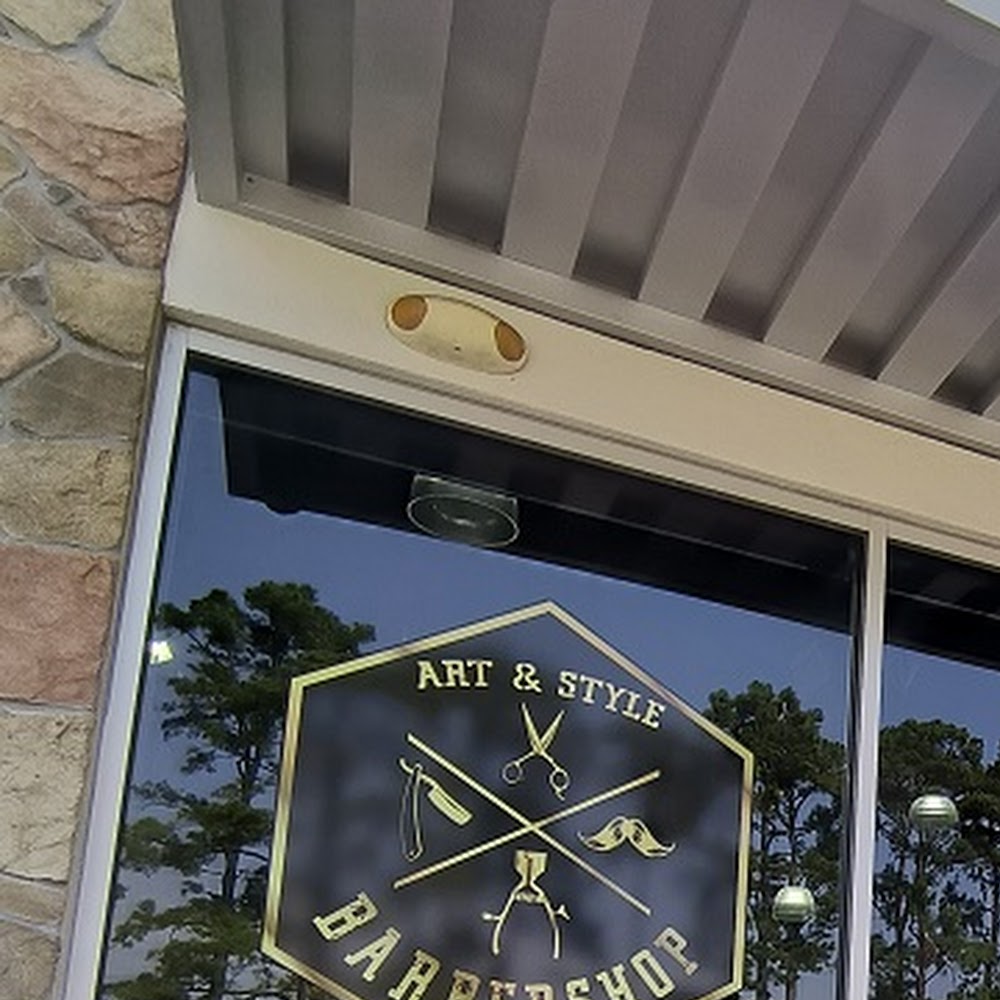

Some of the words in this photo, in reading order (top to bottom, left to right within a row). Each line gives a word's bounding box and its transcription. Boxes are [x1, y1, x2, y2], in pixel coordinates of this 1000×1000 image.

[416, 658, 493, 691] ART
[511, 661, 543, 694] &
[557, 669, 666, 731] STYLE
